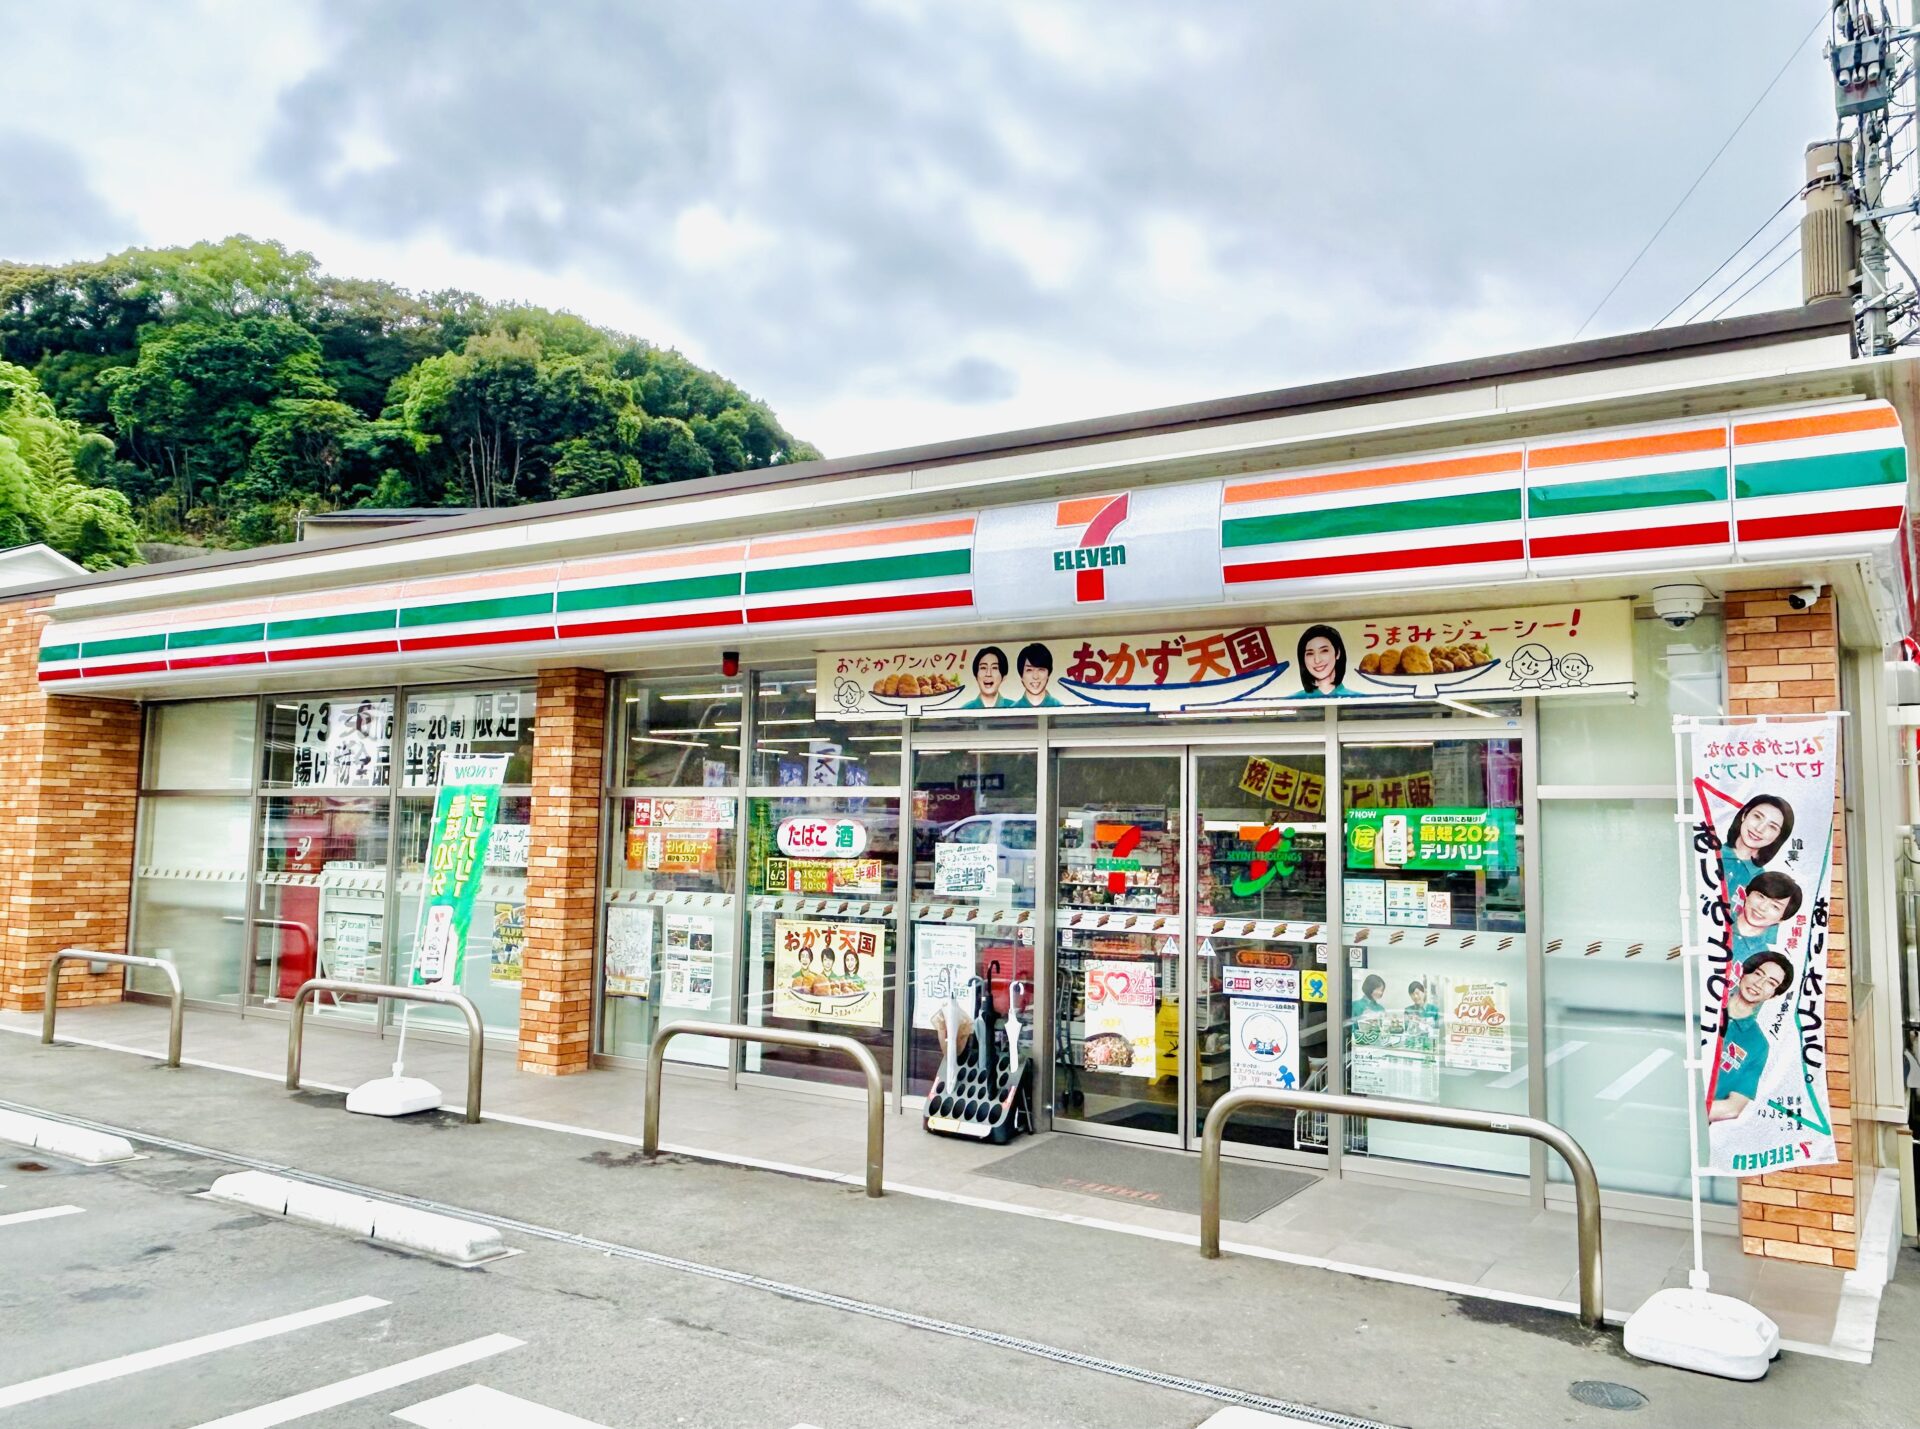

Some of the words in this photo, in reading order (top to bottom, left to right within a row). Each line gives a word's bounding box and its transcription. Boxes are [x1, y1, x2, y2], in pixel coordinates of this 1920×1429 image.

[1054, 545, 1126, 570] ELEVEN
[1363, 609, 1580, 648] うまみジューシー!
[836, 649, 968, 673] おなかワンパク!
[1067, 627, 1278, 684] おかず天国
[1349, 811, 1377, 819] 7NOW
[788, 824, 828, 847] たばこ
[835, 825, 854, 848] 酒
[1420, 825, 1500, 842] 最短20分
[1421, 844, 1499, 860] デリバリー
[770, 869, 785, 880] 6/3
[784, 924, 877, 958] おかず天国
[1457, 1002, 1491, 1022] Pay
